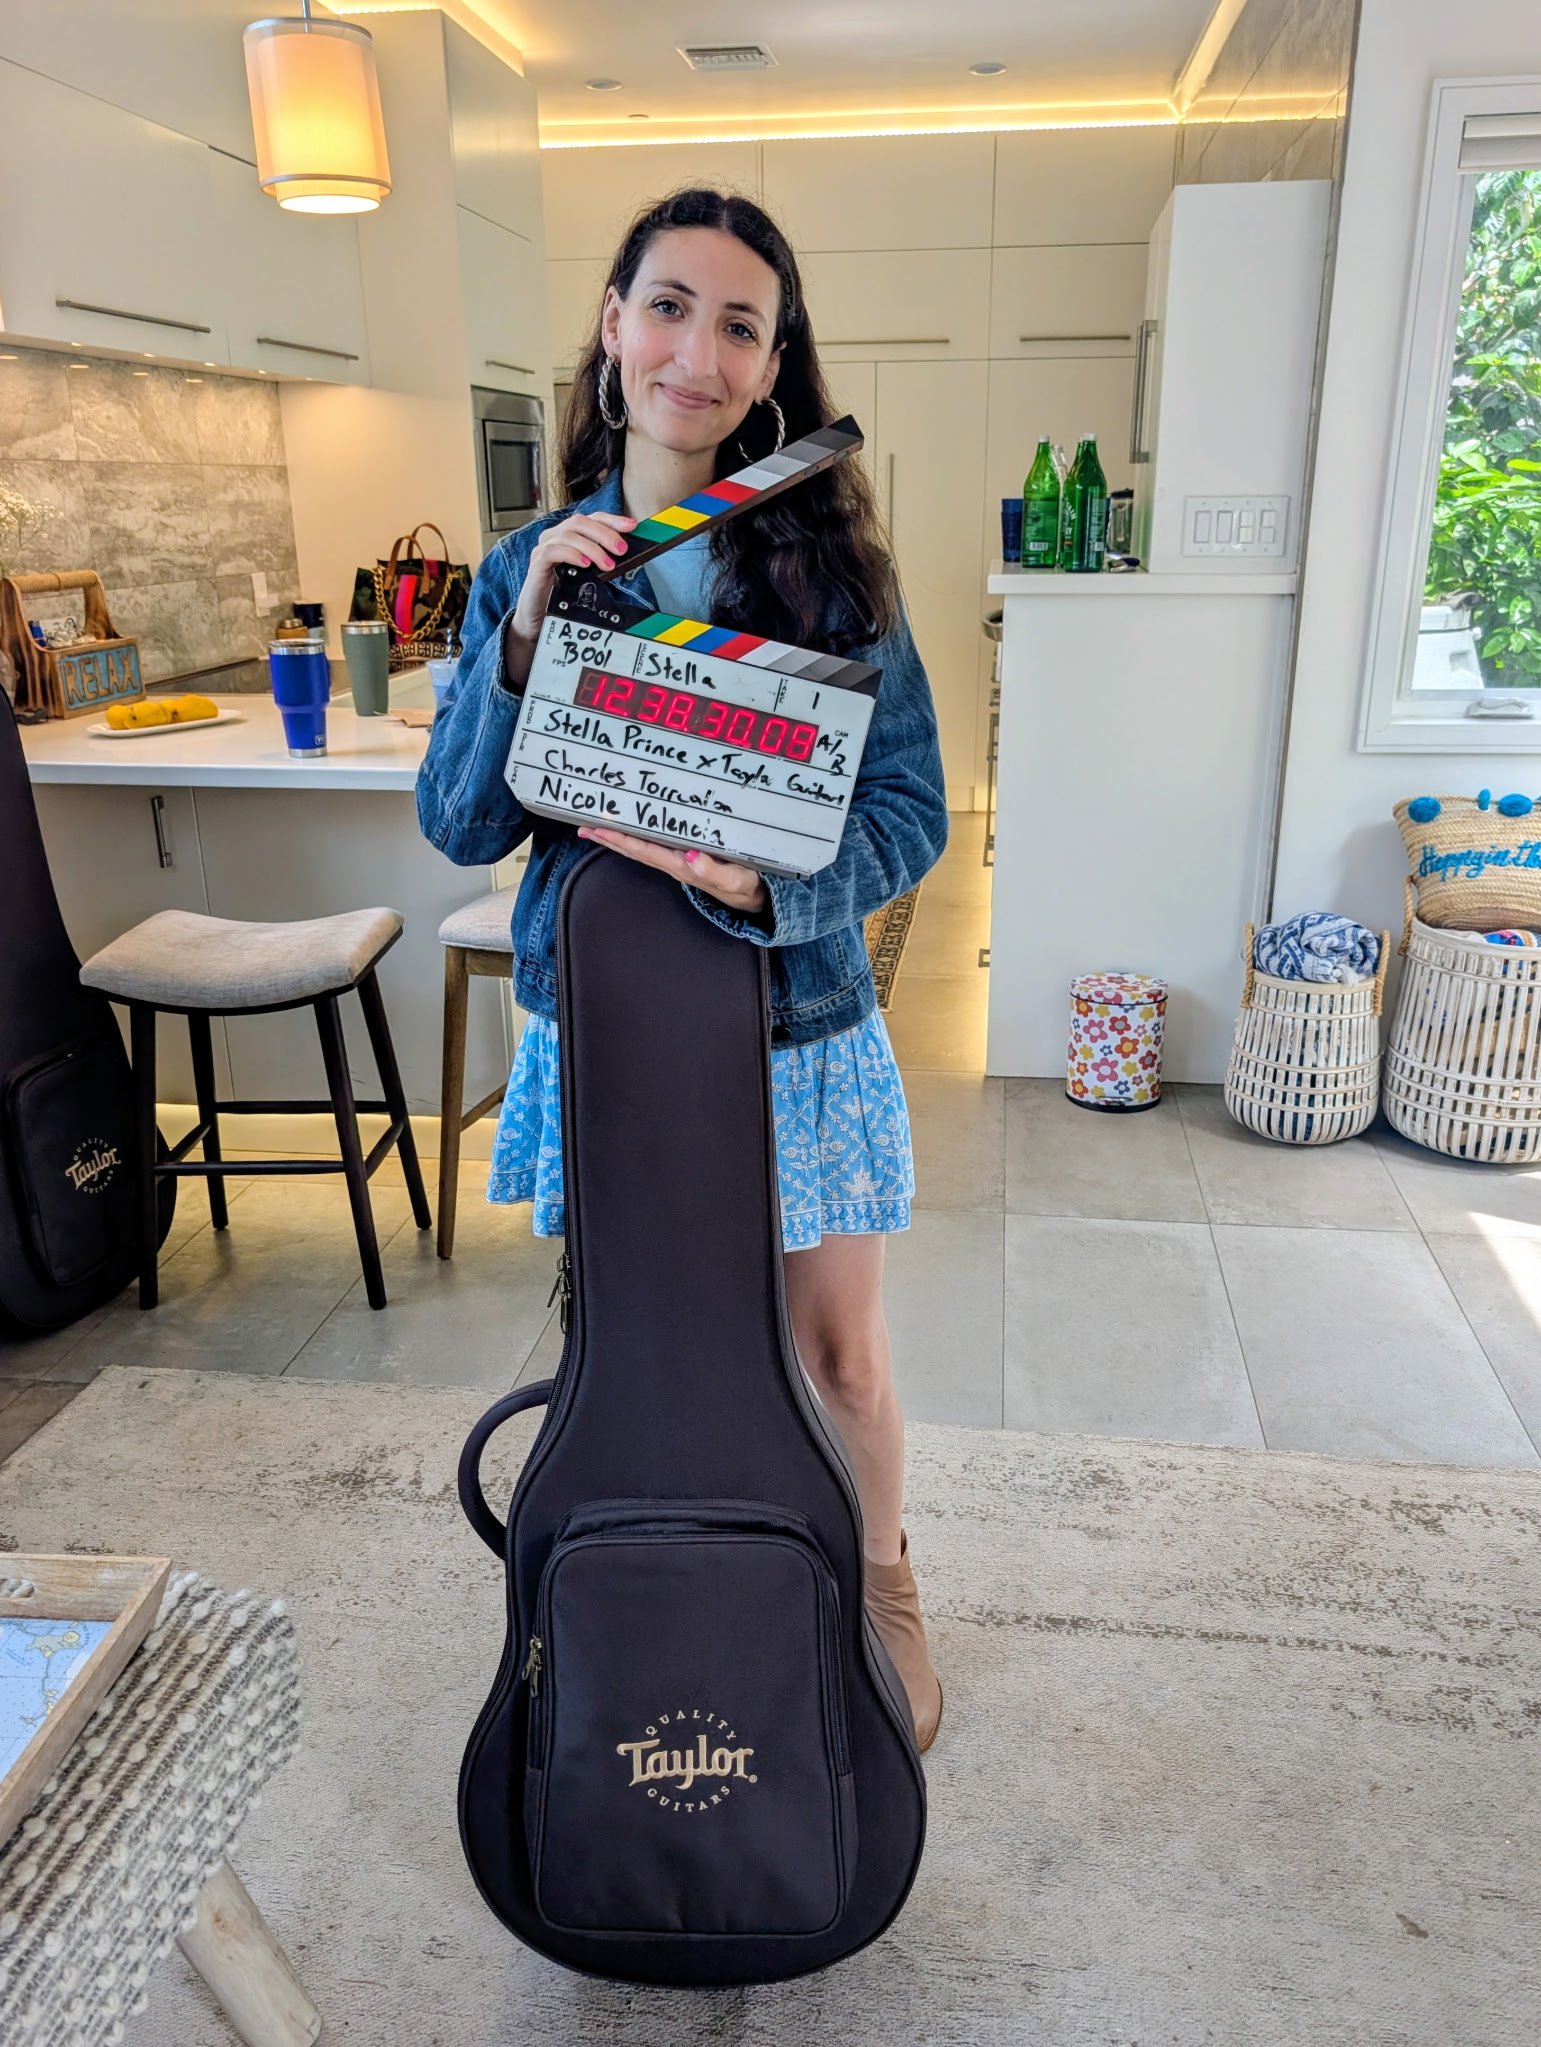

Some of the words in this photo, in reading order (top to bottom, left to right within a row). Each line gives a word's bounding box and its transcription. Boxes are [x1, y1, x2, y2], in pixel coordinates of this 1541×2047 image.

[546, 620, 556, 645] ROLL
[63, 650, 138, 705] RELAX
[552, 658, 566, 668] FPS
[645, 652, 717, 689] Stella
[778, 679, 789, 704] TAKE
[544, 709, 614, 749] Stella
[622, 725, 688, 764] Prince
[834, 729, 849, 739] CAM
[544, 749, 626, 787] Charles
[539, 774, 620, 816] Nicole
[645, 1709, 737, 1740] QUALITY
[647, 1785, 730, 1812] GUITARS
